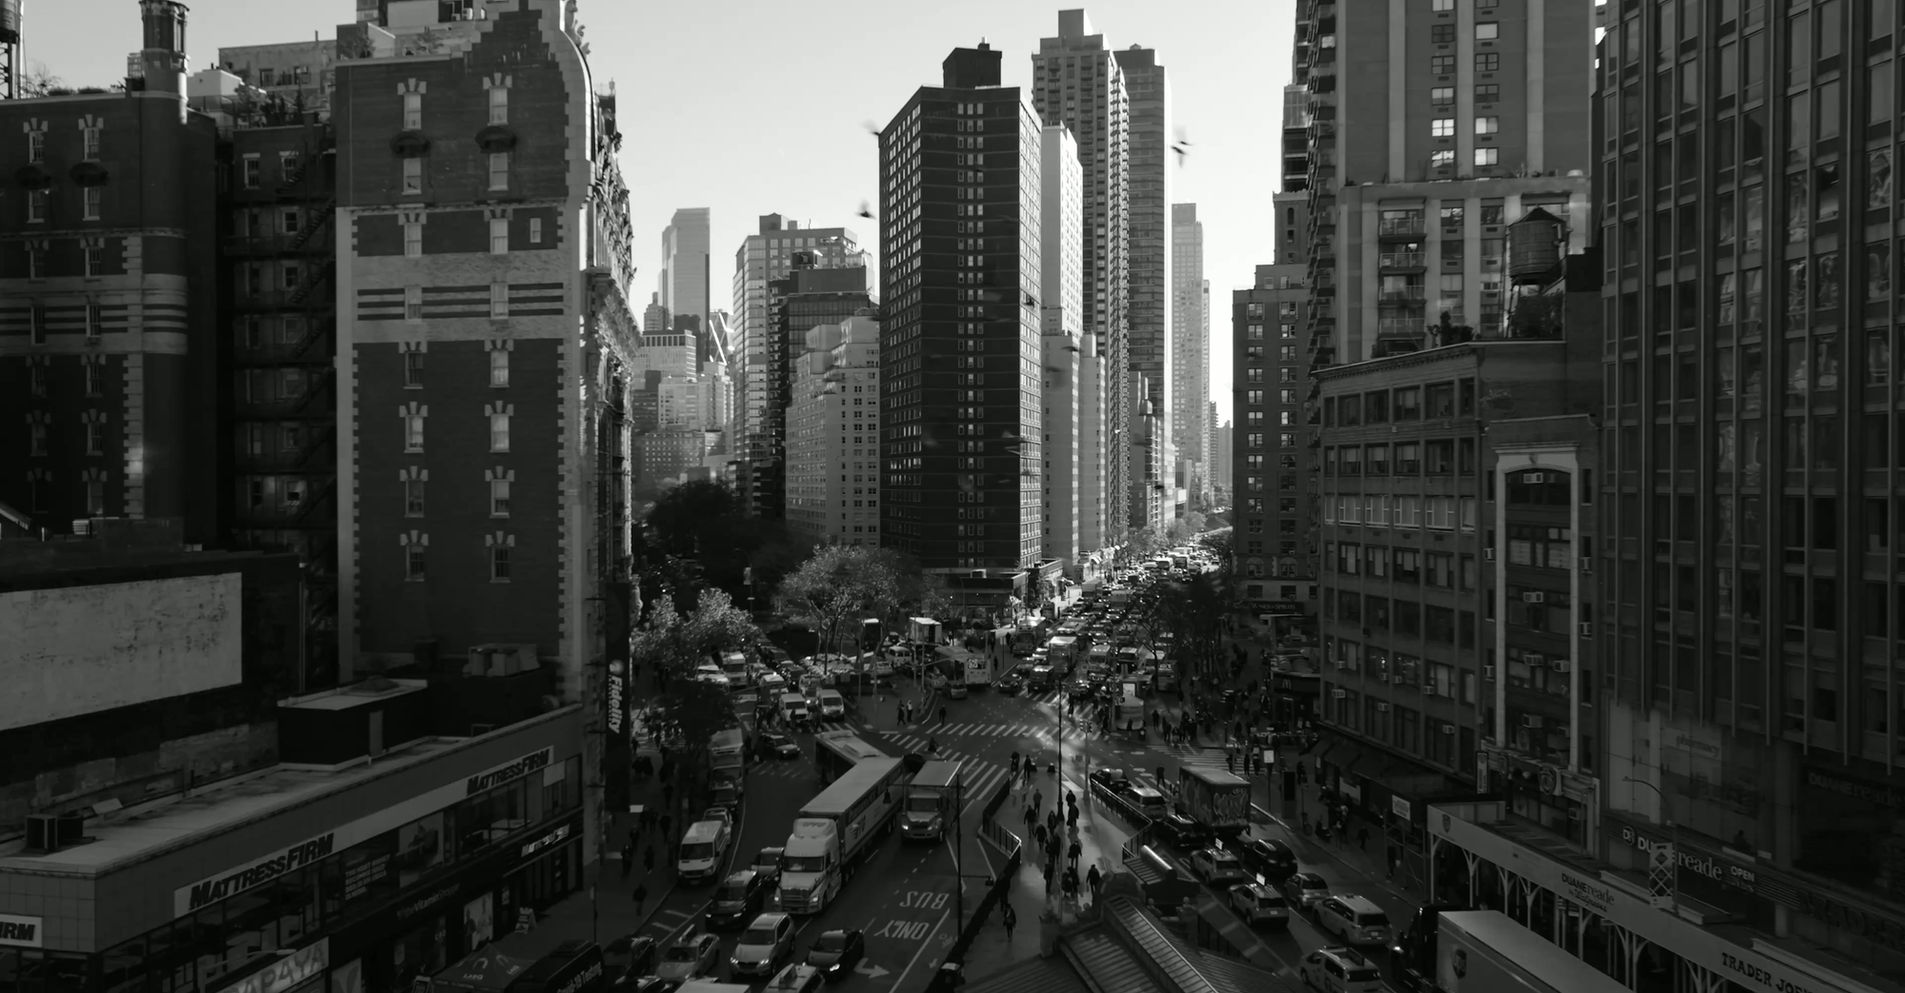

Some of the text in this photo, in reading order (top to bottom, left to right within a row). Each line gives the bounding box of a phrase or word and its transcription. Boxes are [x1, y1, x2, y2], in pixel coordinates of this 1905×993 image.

[608, 674, 623, 735] Fidelity
[1730, 865, 1755, 882] OPEN
[899, 891, 950, 910] BUS
[873, 920, 930, 940] ONLY
[1722, 952, 1773, 987] TRADER
